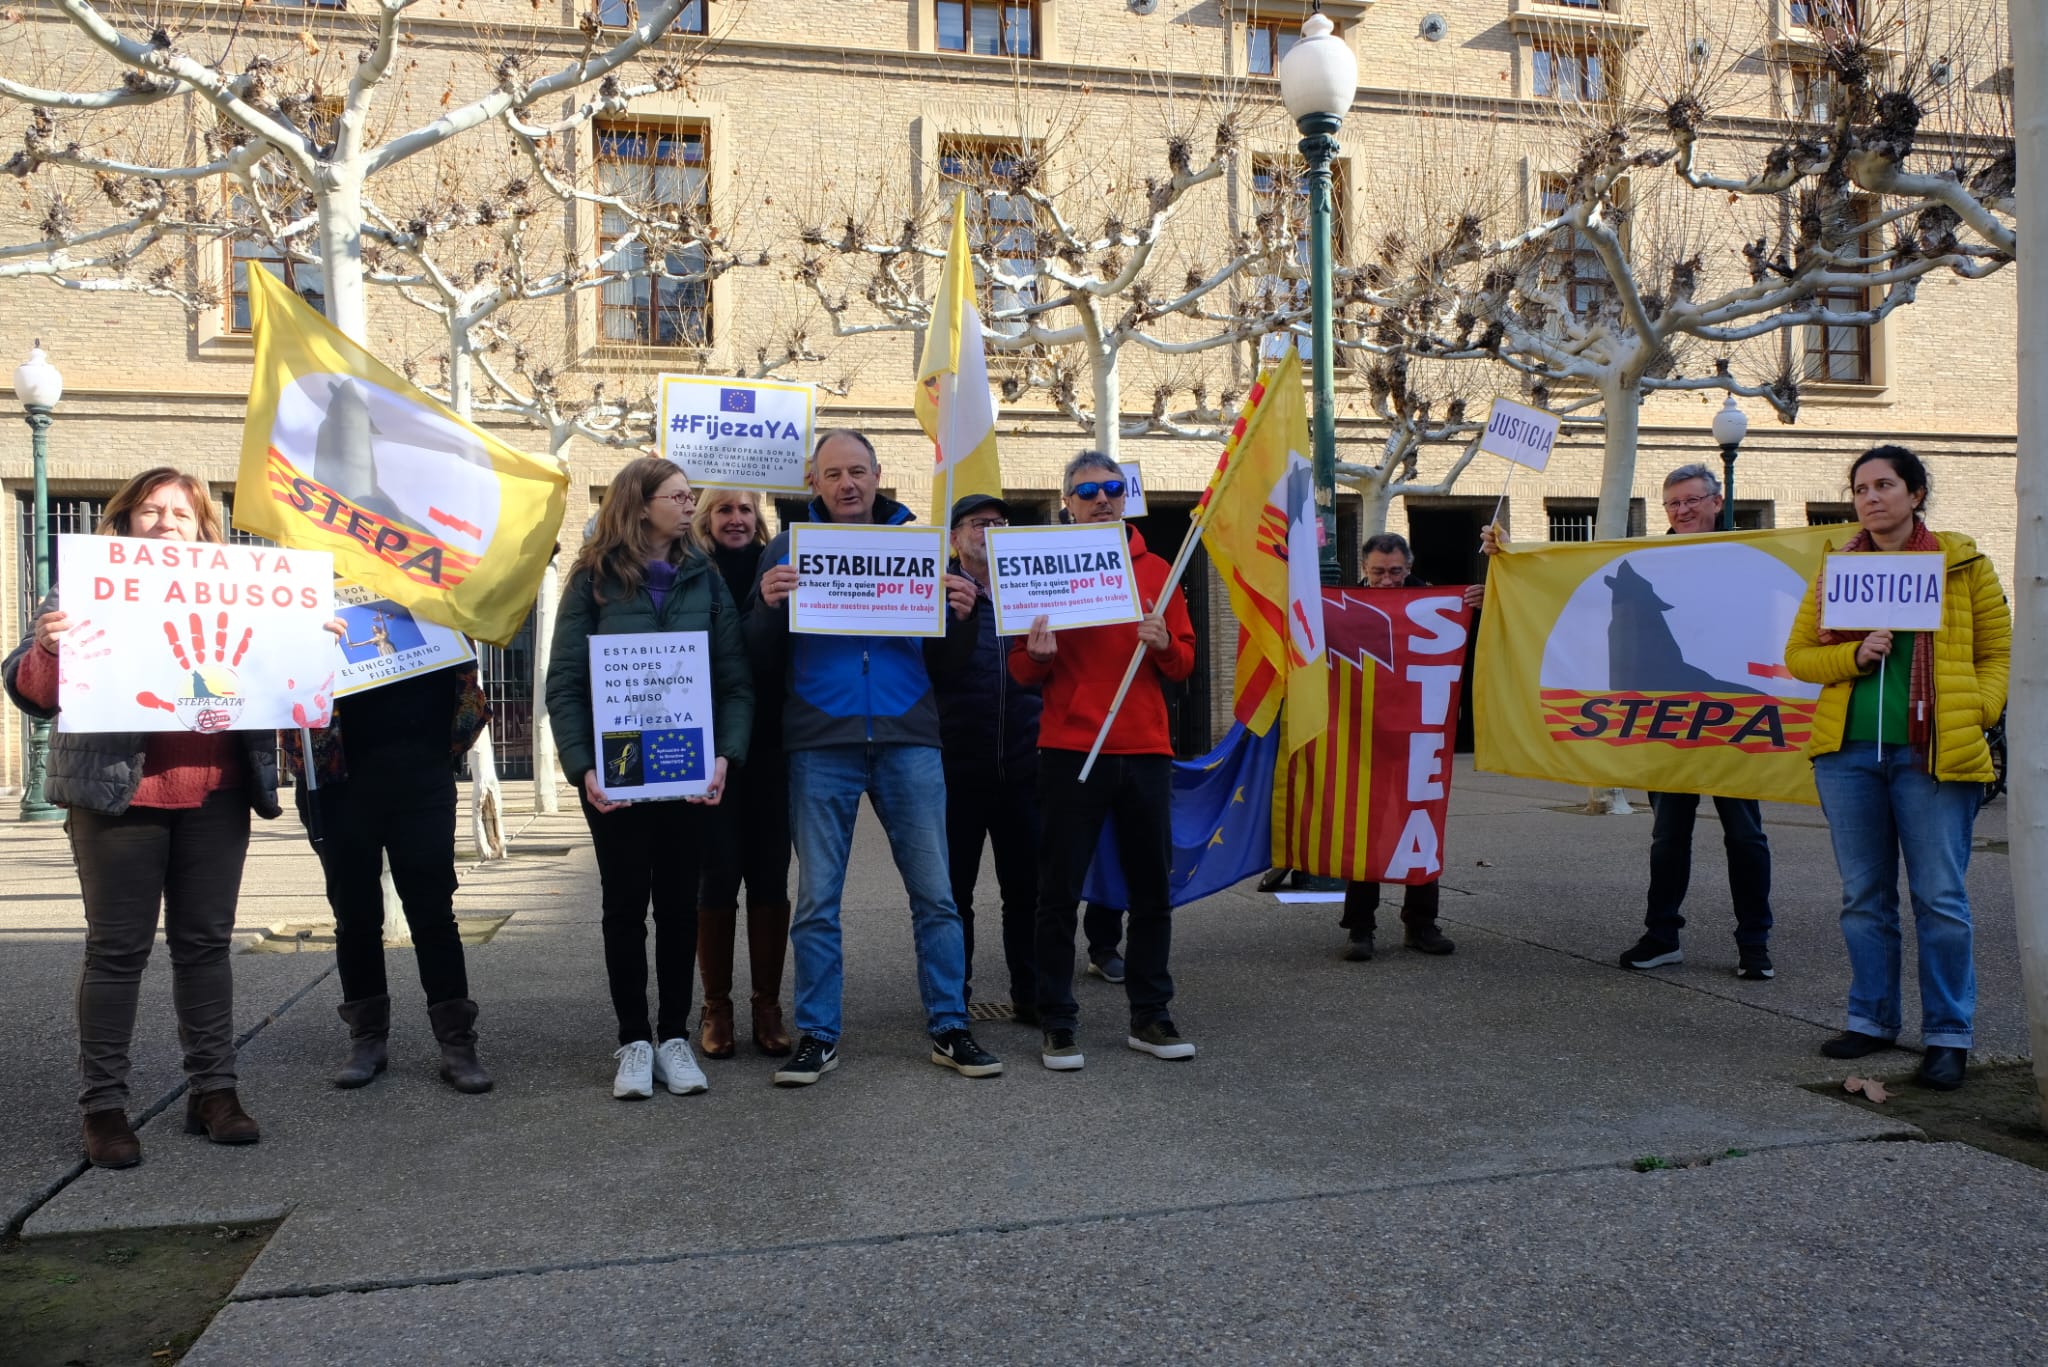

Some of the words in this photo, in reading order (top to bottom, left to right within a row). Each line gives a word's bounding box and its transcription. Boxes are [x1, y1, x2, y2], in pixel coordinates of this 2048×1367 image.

[670, 414, 800, 441] #FijezaYA
[1488, 412, 1553, 454] JUSTICIA
[672, 451, 715, 459] OBLIGADO
[718, 454, 780, 464] CUMPLIMIENTO
[721, 446, 764, 455] EUROPEAS
[687, 458, 719, 467] ENCIMA
[721, 461, 758, 470] INCLUSO
[288, 477, 443, 584] STEPA
[109, 542, 229, 570] BASTA
[249, 551, 291, 573] YA
[799, 553, 935, 578] ESTABILIZAR
[997, 551, 1122, 577] ESTABILIZAR
[344, 586, 366, 595] POR
[810, 580, 830, 588] hacer
[832, 581, 845, 590] fijo
[854, 581, 876, 590] quien
[876, 582, 904, 598] por
[909, 579, 933, 599] ley
[1010, 581, 1029, 589] hacer
[1030, 580, 1042, 589] fijo
[1049, 580, 1069, 589] quien
[1070, 577, 1095, 594] por
[1099, 572, 1123, 589] ley
[1828, 574, 1939, 603] JUSTICIA
[94, 577, 139, 602] DE
[164, 580, 317, 609] ABUSOS
[828, 590, 876, 598] corresponde
[1028, 588, 1070, 597] corresponde
[810, 602, 839, 610] subastar
[871, 604, 898, 612] puestos
[910, 604, 935, 614] trabajo
[1012, 601, 1039, 610] subastar
[1040, 600, 1067, 608] nuestros
[1068, 598, 1094, 607] puestos
[1104, 593, 1128, 601] trabajo
[603, 645, 696, 656] ESTABILIZAR
[341, 668, 354, 677] EL
[359, 657, 393, 673] ÚNICO
[397, 645, 441, 662] CAMINO
[604, 663, 628, 672] CON
[632, 662, 662, 671] OPES
[369, 665, 406, 680] FIJEZA
[409, 660, 425, 669] YA
[605, 679, 621, 688] NO
[625, 679, 639, 687] ES
[642, 675, 693, 687] SANCIÓN
[606, 695, 620, 704] AL
[624, 693, 662, 703] ABUSO
[614, 712, 693, 726] #FijezaYA
[1570, 698, 1788, 748] STEPA
[1384, 596, 1467, 879] STEA
